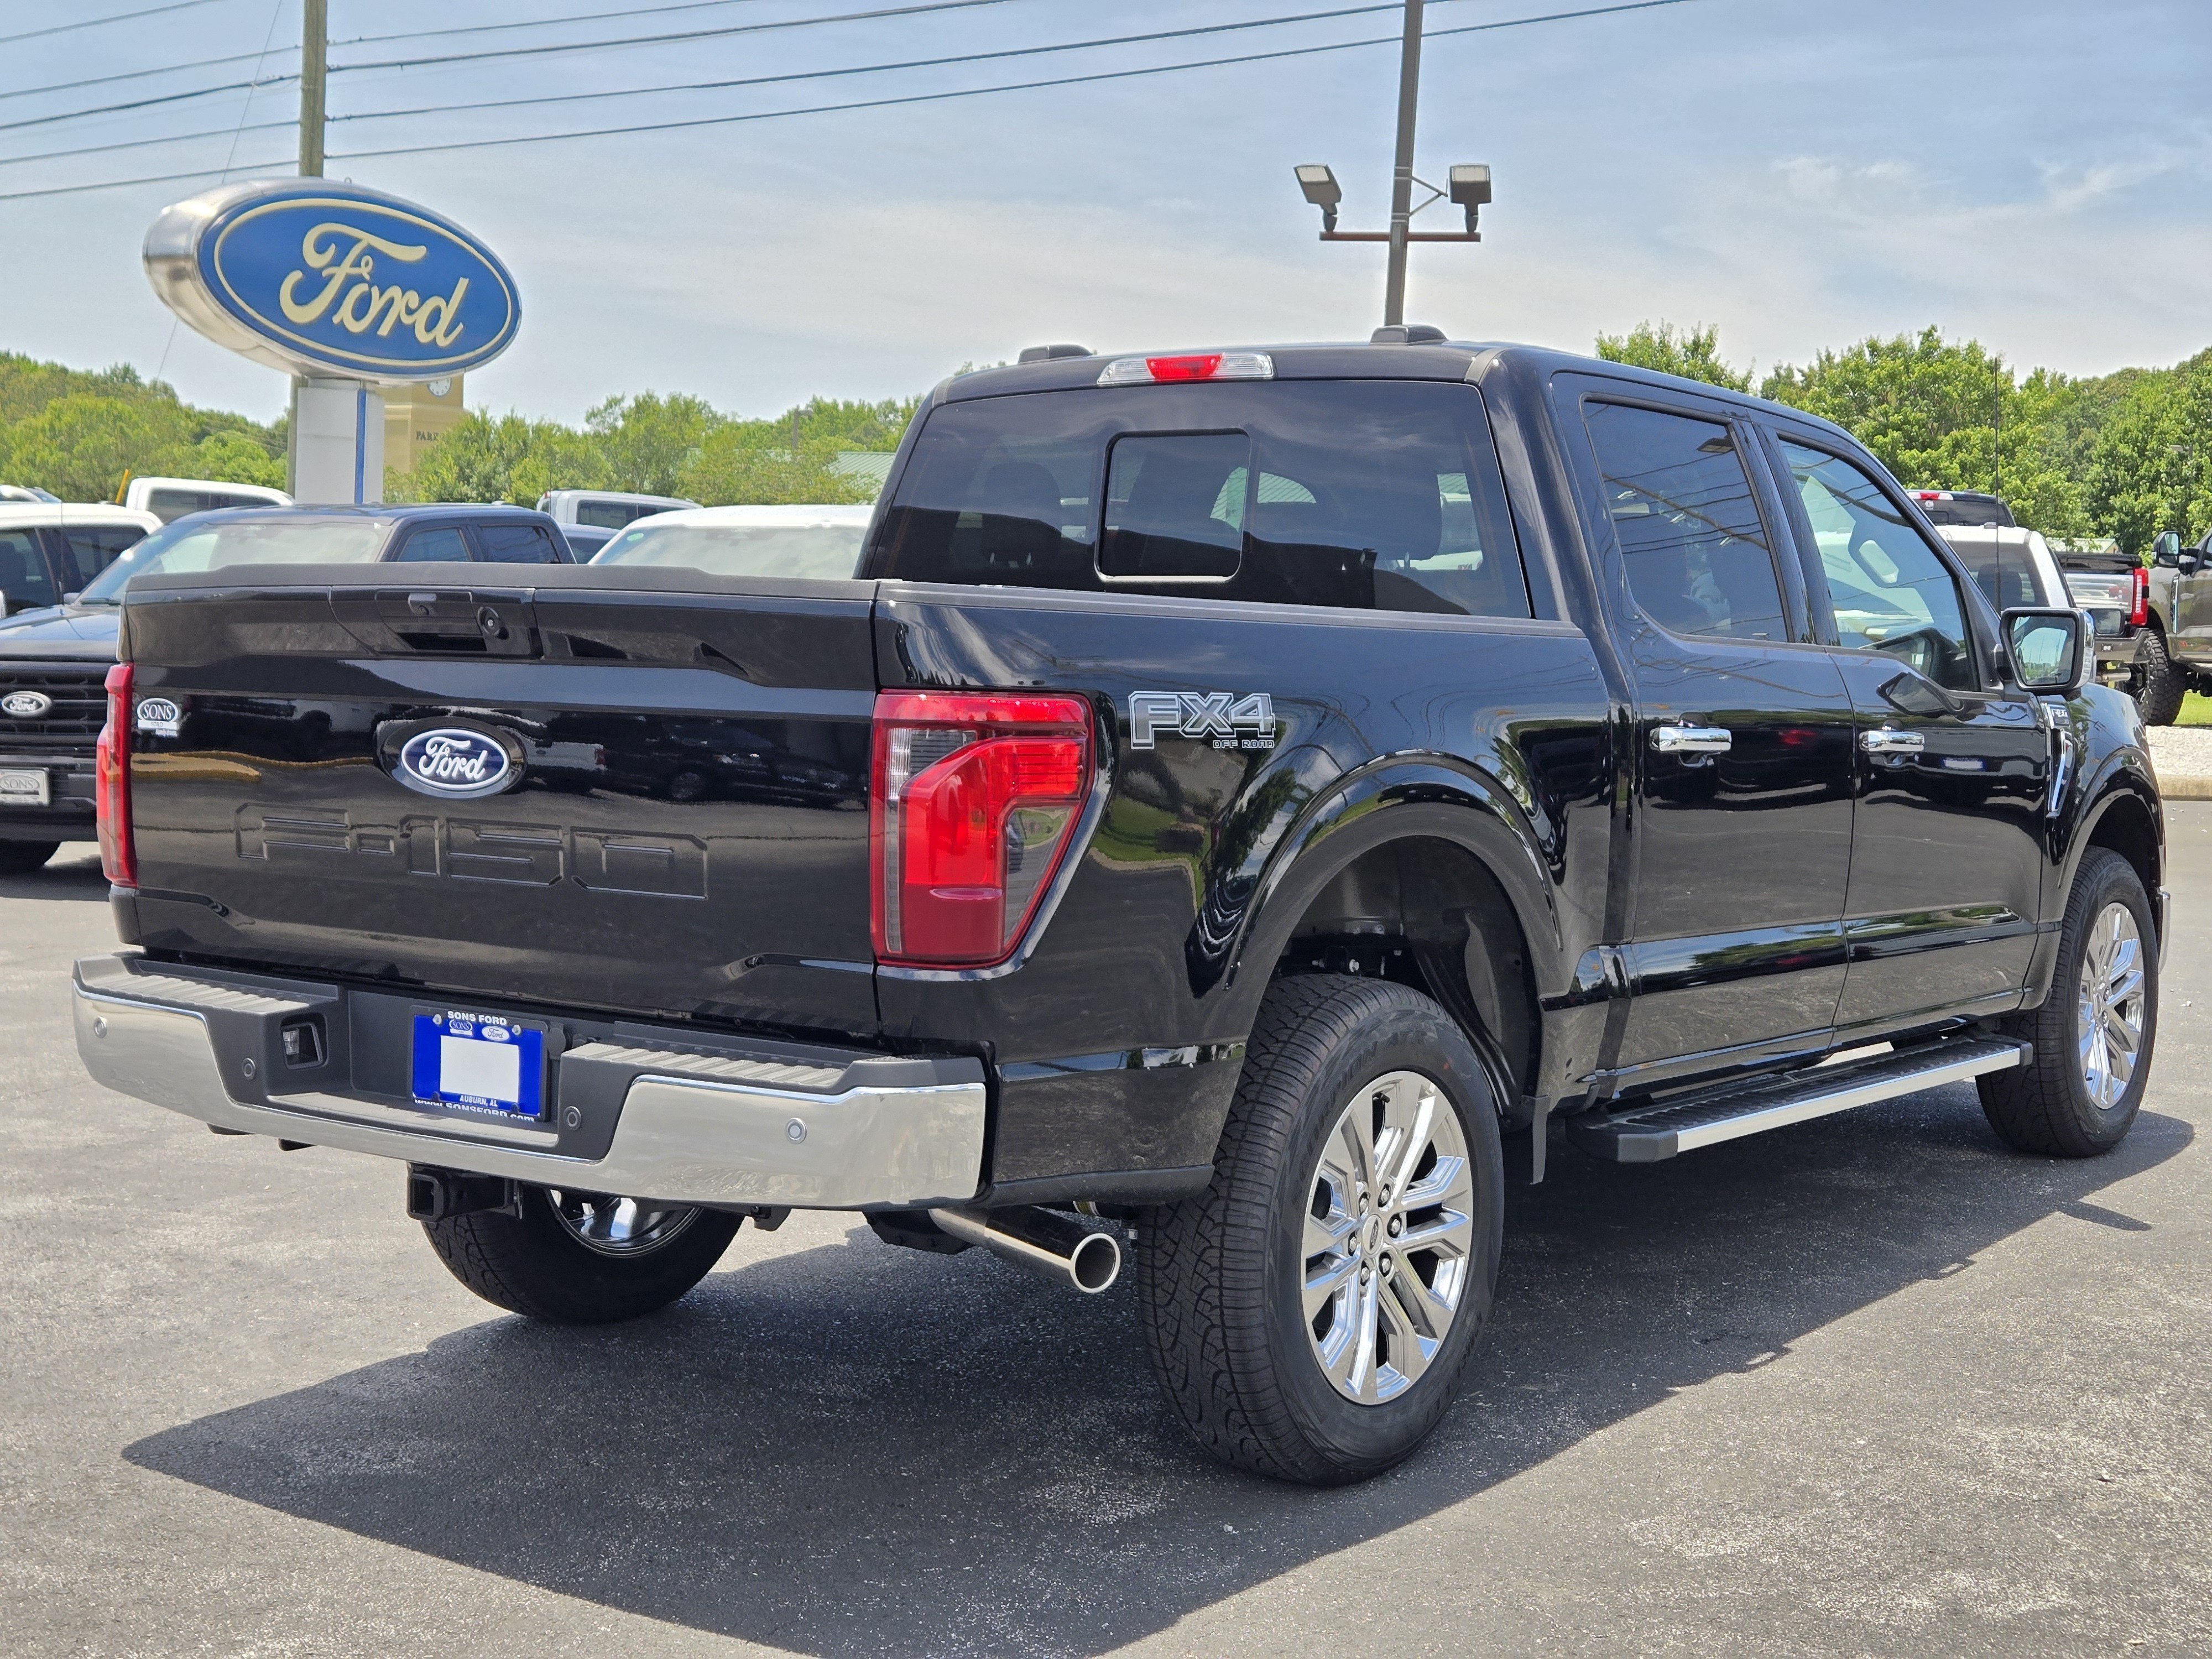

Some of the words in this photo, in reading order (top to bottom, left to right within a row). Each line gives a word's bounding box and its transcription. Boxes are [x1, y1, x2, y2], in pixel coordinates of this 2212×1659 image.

[279, 222, 469, 347] Ford
[9, 697, 36, 711] Ford
[143, 704, 172, 720] SONS
[1129, 691, 1275, 749] FX4
[1213, 740, 1238, 749] OFF
[1242, 740, 1275, 749] ROAD
[419, 736, 488, 779] Ford
[3, 778, 34, 789] SONS
[447, 1010, 476, 1021] SONS
[478, 1014, 507, 1025] FORD
[452, 1021, 469, 1030] SONS
[487, 1027, 504, 1039] Ford
[460, 1095, 488, 1106] AUBURN,
